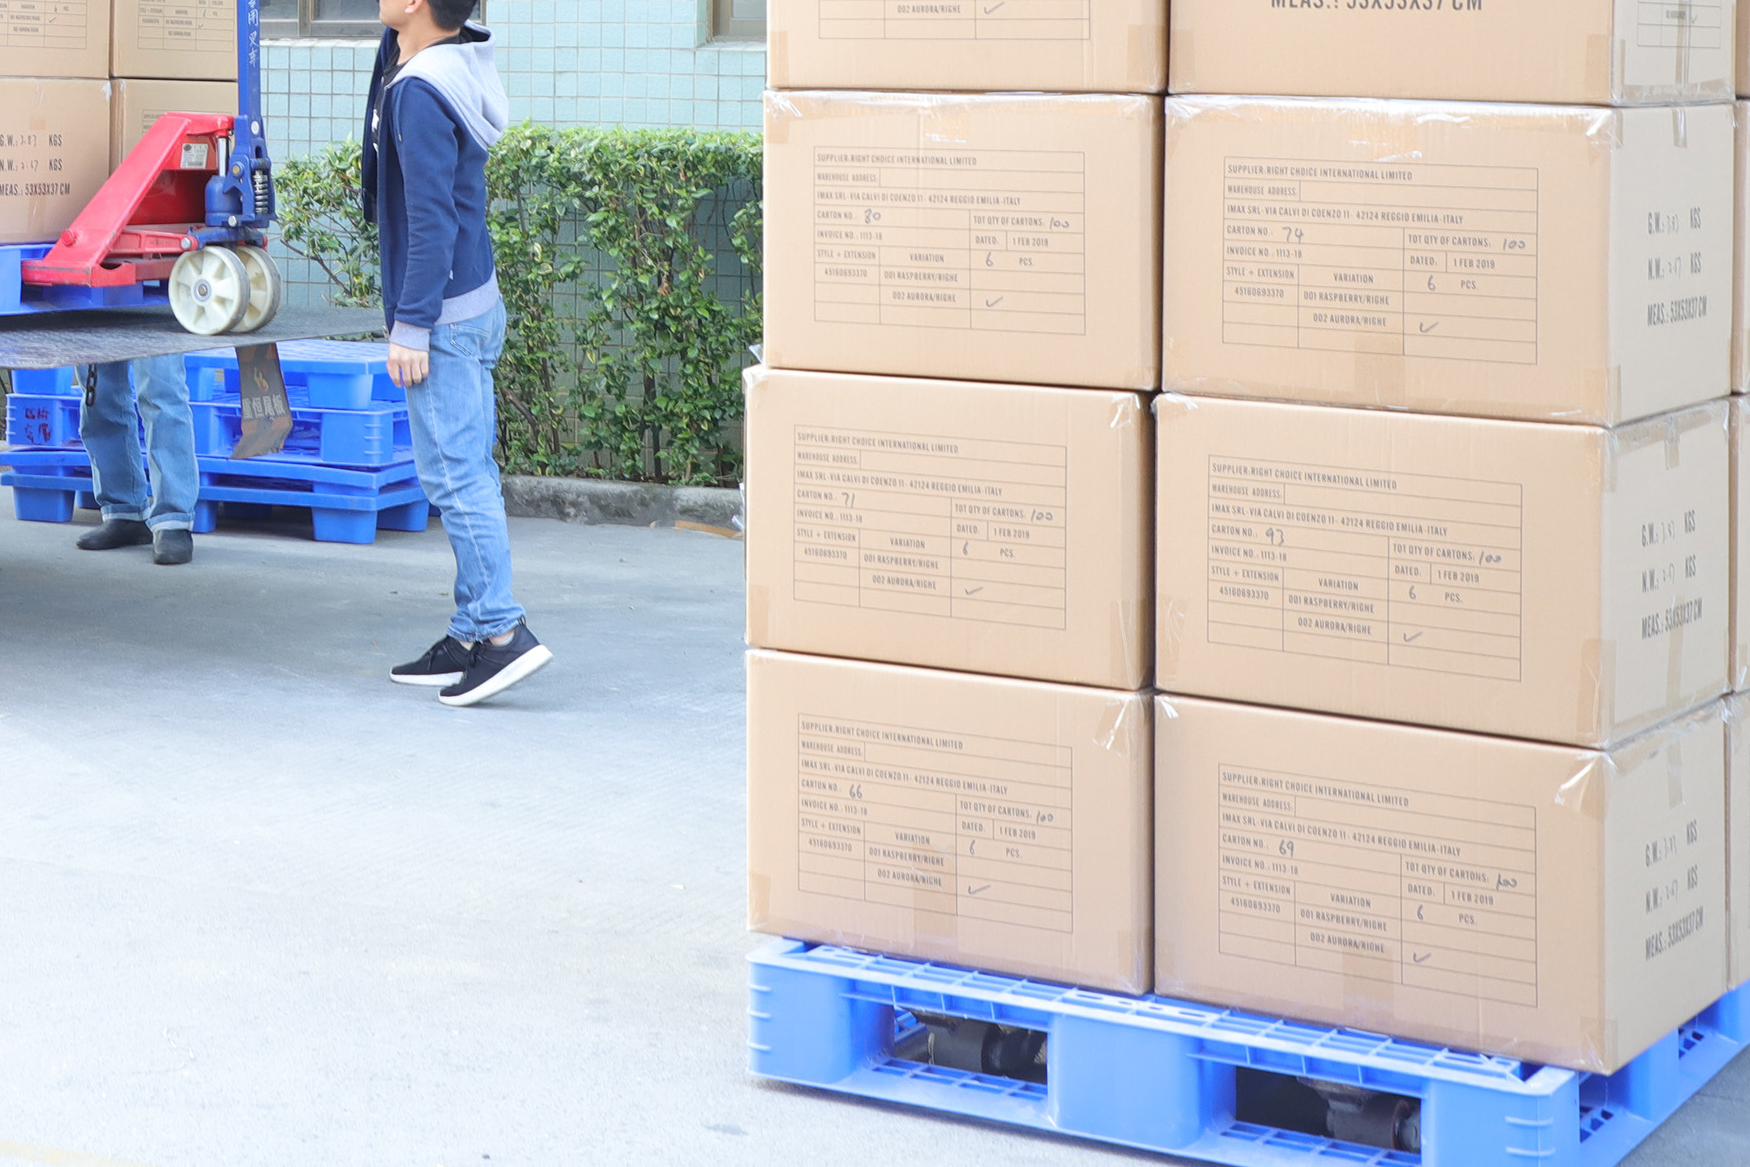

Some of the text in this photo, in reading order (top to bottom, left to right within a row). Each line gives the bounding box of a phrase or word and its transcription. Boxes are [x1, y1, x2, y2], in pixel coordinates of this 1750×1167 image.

[0, 134, 18, 146] G.W.:
[49, 134, 62, 147] KGS
[0, 159, 18, 171] N.W.:
[49, 158, 62, 171] KGS
[1290, 167, 1318, 176] CHOICE
[1320, 168, 1378, 179] INTERNATIONAL
[1381, 170, 1412, 180] LIMITED
[0, 183, 70, 195] MEAS.: 53X53X37 CM
[1227, 184, 1264, 194] WAREHOUSE
[1227, 204, 1245, 214] IMAX
[1278, 207, 1299, 216] CALVI
[1301, 208, 1309, 217] DI
[1311, 208, 1341, 218] COENZO
[1356, 210, 1378, 220] 42124
[1381, 211, 1409, 222] REGGIO
[1648, 207, 1701, 235] G.W.: KGS
[1227, 225, 1255, 234] CARTON
[1282, 226, 1304, 243] 74
[1408, 234, 1421, 243] TOT
[1424, 235, 1438, 244] QTY
[1440, 236, 1449, 245] OF
[1227, 245, 1255, 255] INVOICE
[1453, 257, 1495, 269] 1 FEB 2019
[1648, 251, 1701, 280] N.W.: KGS
[1226, 266, 1246, 276] STYLE
[1257, 268, 1294, 279] EXTENSION
[1333, 272, 1373, 283] VARIATION
[1427, 274, 1435, 291] 6
[1304, 291, 1316, 300] 001
[1647, 295, 1707, 326] MEAS.: 53X53X37 CM
[1313, 313, 1327, 322] 002
